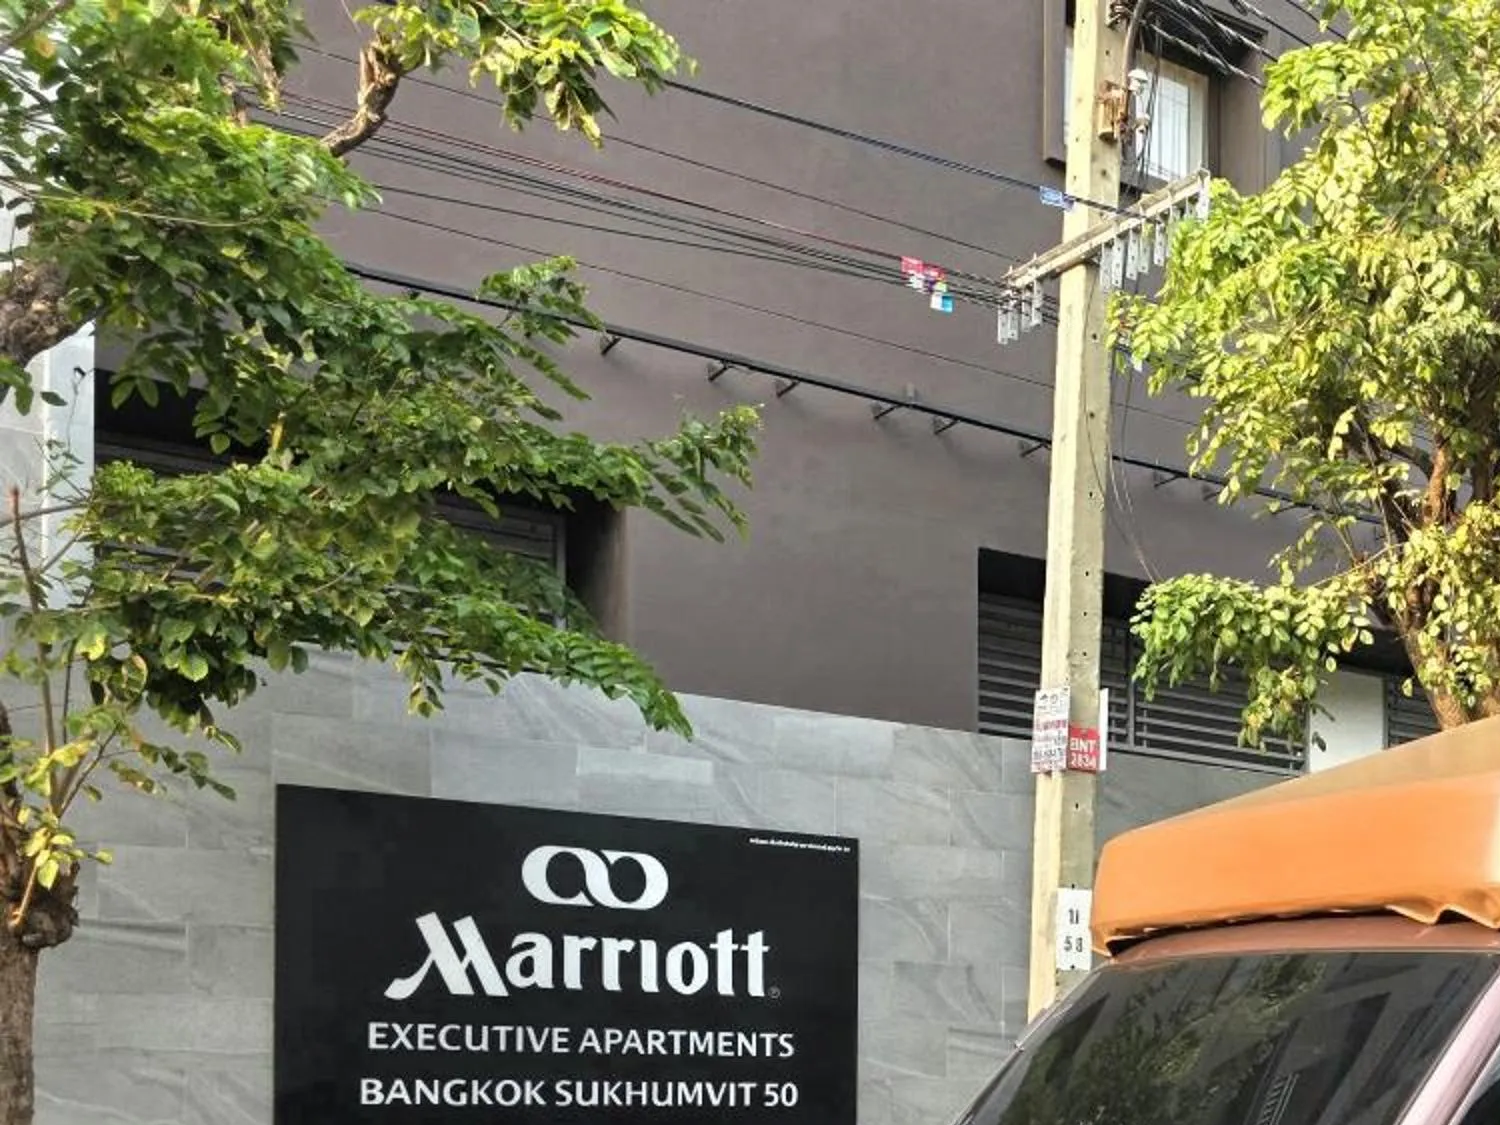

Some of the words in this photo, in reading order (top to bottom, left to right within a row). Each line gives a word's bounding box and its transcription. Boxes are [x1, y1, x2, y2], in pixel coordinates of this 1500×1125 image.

[383, 910, 771, 999] Marriott
[367, 1021, 571, 1054] EXECUTIVE
[578, 1027, 796, 1058] APARTMENTS
[360, 1078, 547, 1107] BANGKOK
[554, 1079, 758, 1107] SUKHUMVIT
[763, 1081, 800, 1108] 50
